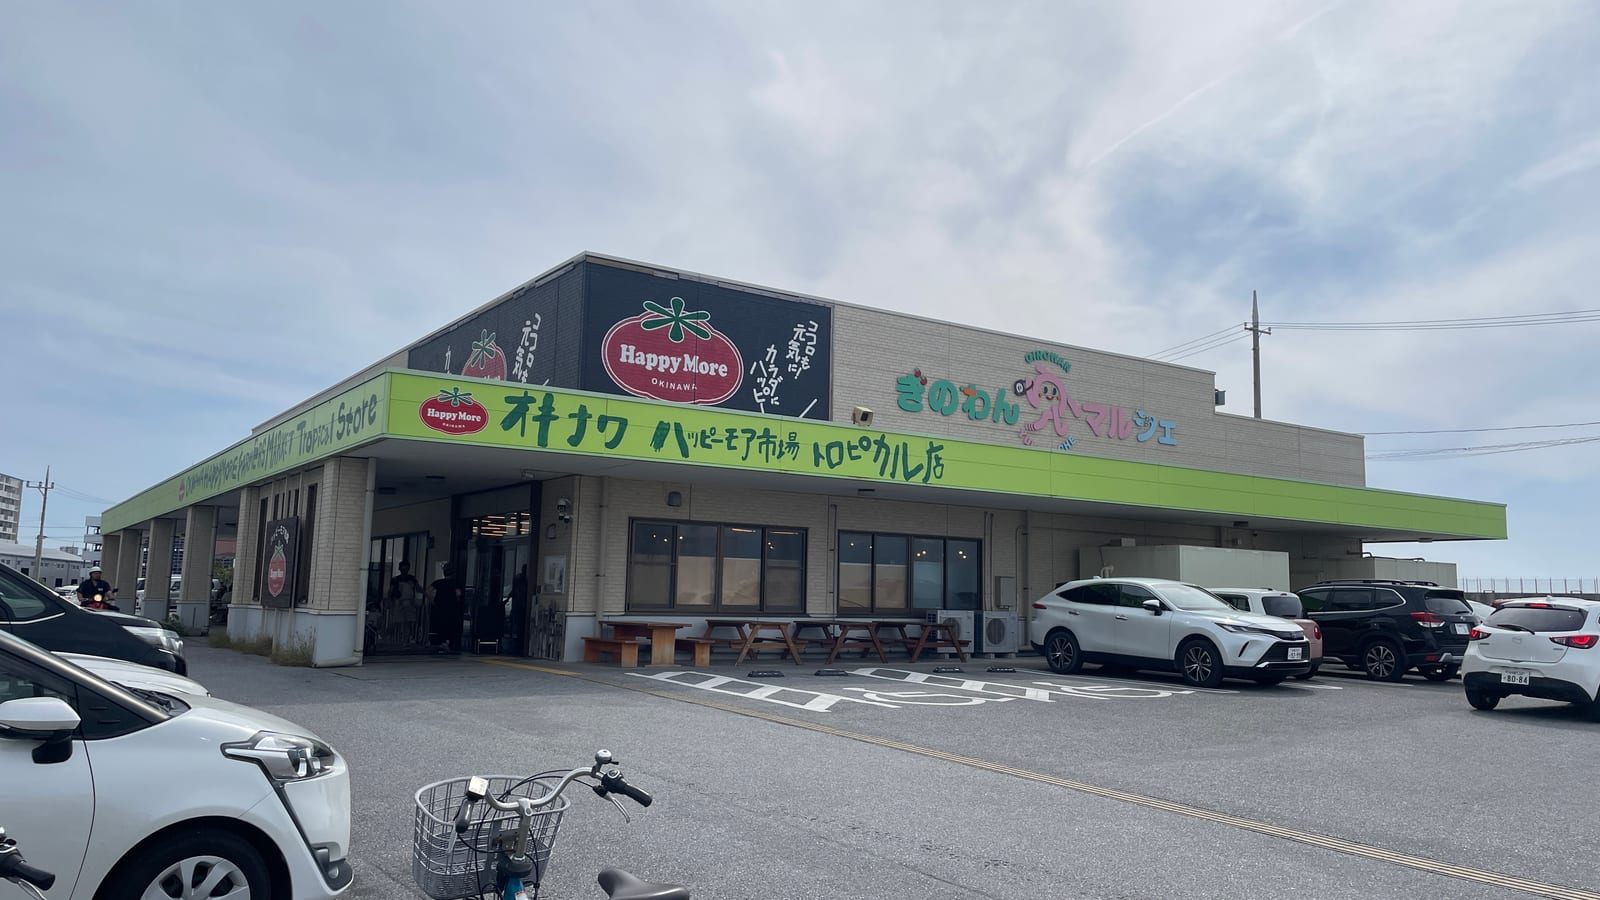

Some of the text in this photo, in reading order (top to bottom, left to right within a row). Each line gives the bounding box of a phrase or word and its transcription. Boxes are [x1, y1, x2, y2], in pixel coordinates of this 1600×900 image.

[619, 343, 728, 378] Happy More
[800, 320, 819, 370] ココロも
[1024, 350, 1072, 373] GINOWAN
[651, 378, 698, 391] OKINAWA
[765, 344, 784, 405] カラダに
[895, 368, 1020, 426] ぎのわん
[297, 412, 335, 456] Tropical
[336, 393, 377, 441] Store
[426, 407, 482, 422] Happy More
[500, 390, 945, 484] オキナワ ハッピーモア市場 トロピカル店
